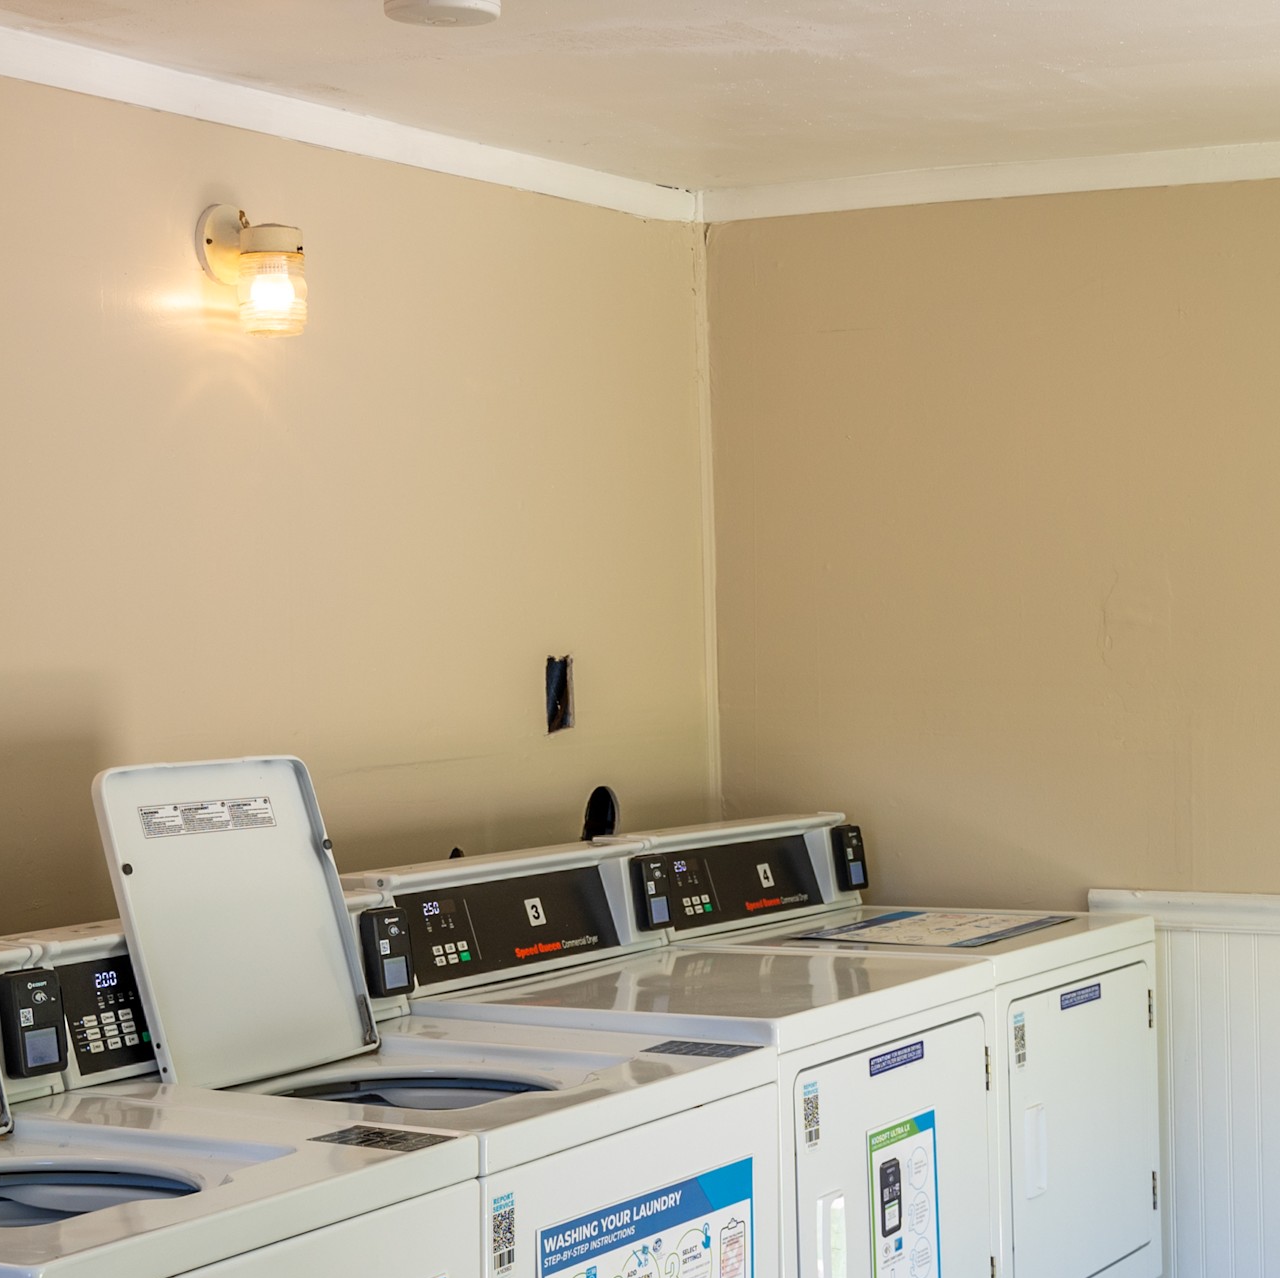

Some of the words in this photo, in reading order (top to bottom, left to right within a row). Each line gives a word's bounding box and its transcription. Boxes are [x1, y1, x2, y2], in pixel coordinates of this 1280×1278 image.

[763, 869, 770, 882] 4
[531, 904, 540, 920] 3
[515, 944, 539, 959] Speed
[538, 942, 562, 953] Queen
[561, 936, 586, 949] Commercial
[586, 935, 598, 945] Dryer
[95, 970, 117, 988] 2.00
[493, 1192, 513, 1205] REPORT
[493, 1200, 514, 1213] SERVICE
[543, 1219, 598, 1254] WASHING
[601, 1207, 630, 1233] YOUR
[633, 1189, 681, 1221] LAUNDRY
[543, 1242, 589, 1268] STEP-BY-STEP
[590, 1224, 635, 1251] INSTRUCTIONS
[682, 1244, 697, 1256] SELECT
[626, 1268, 636, 1278] ADD
